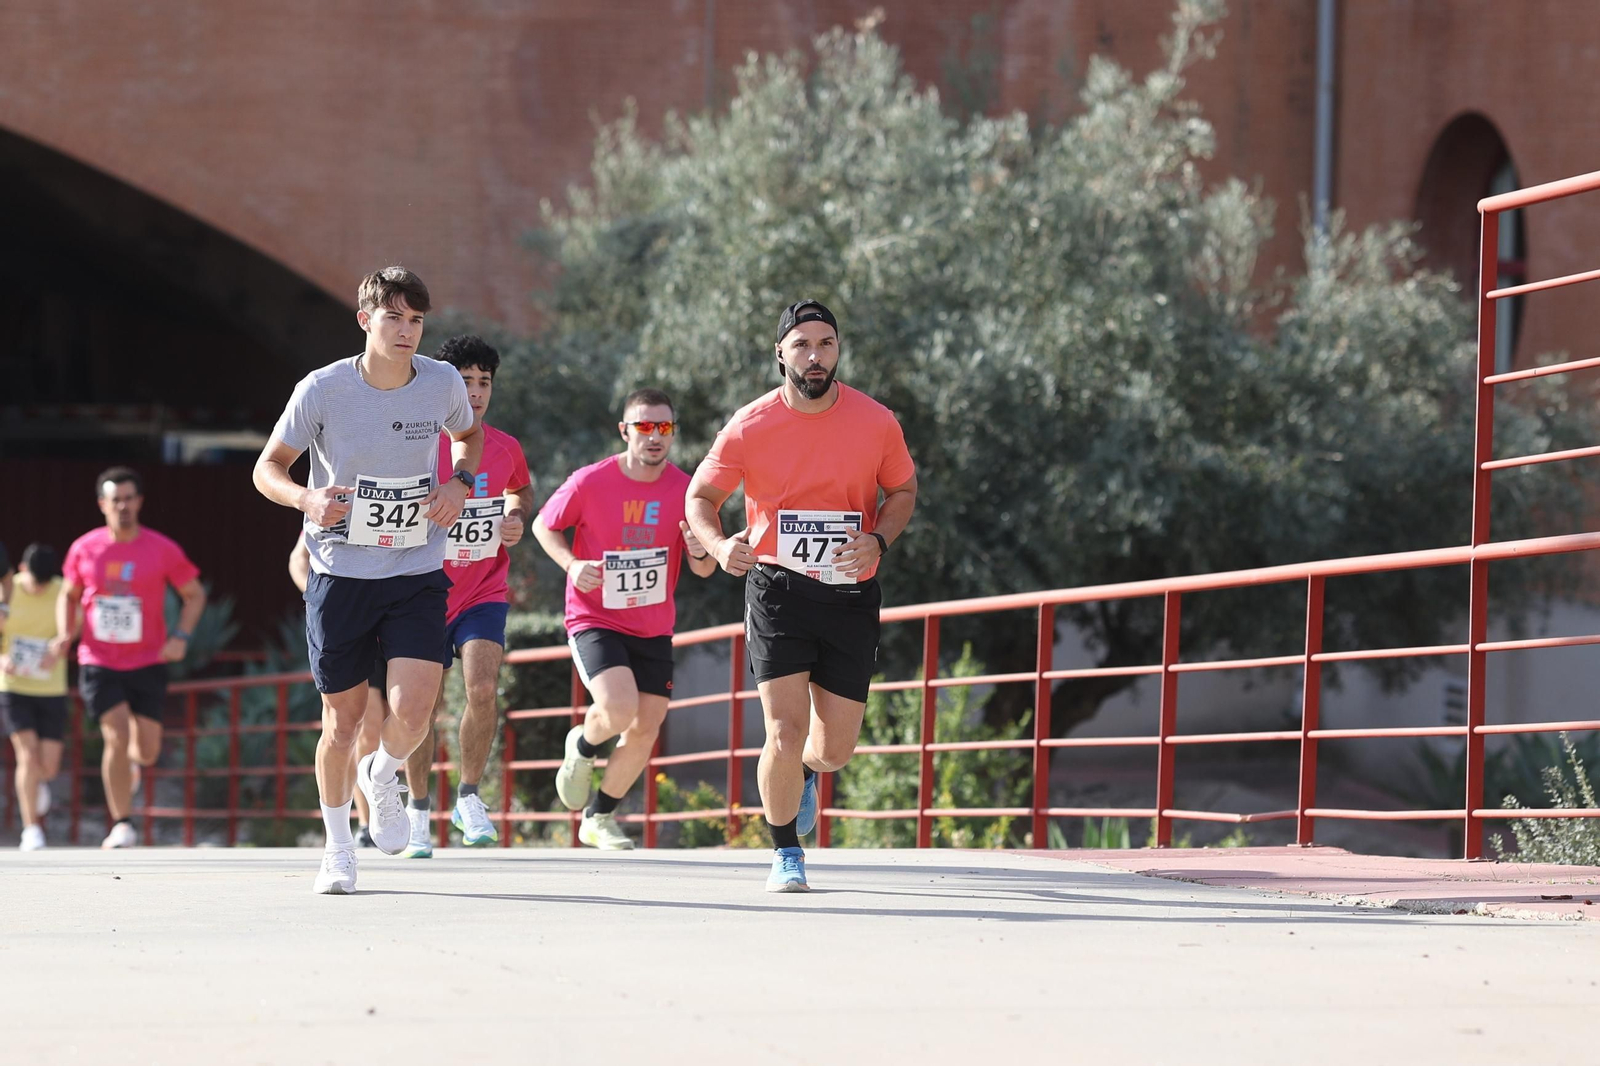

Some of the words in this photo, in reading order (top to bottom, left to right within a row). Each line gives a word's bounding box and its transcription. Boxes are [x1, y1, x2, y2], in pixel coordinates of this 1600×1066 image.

[360, 488, 396, 500] UMA
[474, 472, 488, 497] E
[366, 502, 420, 528] 342
[623, 500, 660, 525] WE
[448, 520, 493, 543] 463
[782, 523, 819, 532] UMA
[379, 536, 393, 546] WE
[792, 538, 848, 562] 477
[607, 560, 636, 569] UMA
[617, 570, 658, 592] 119
